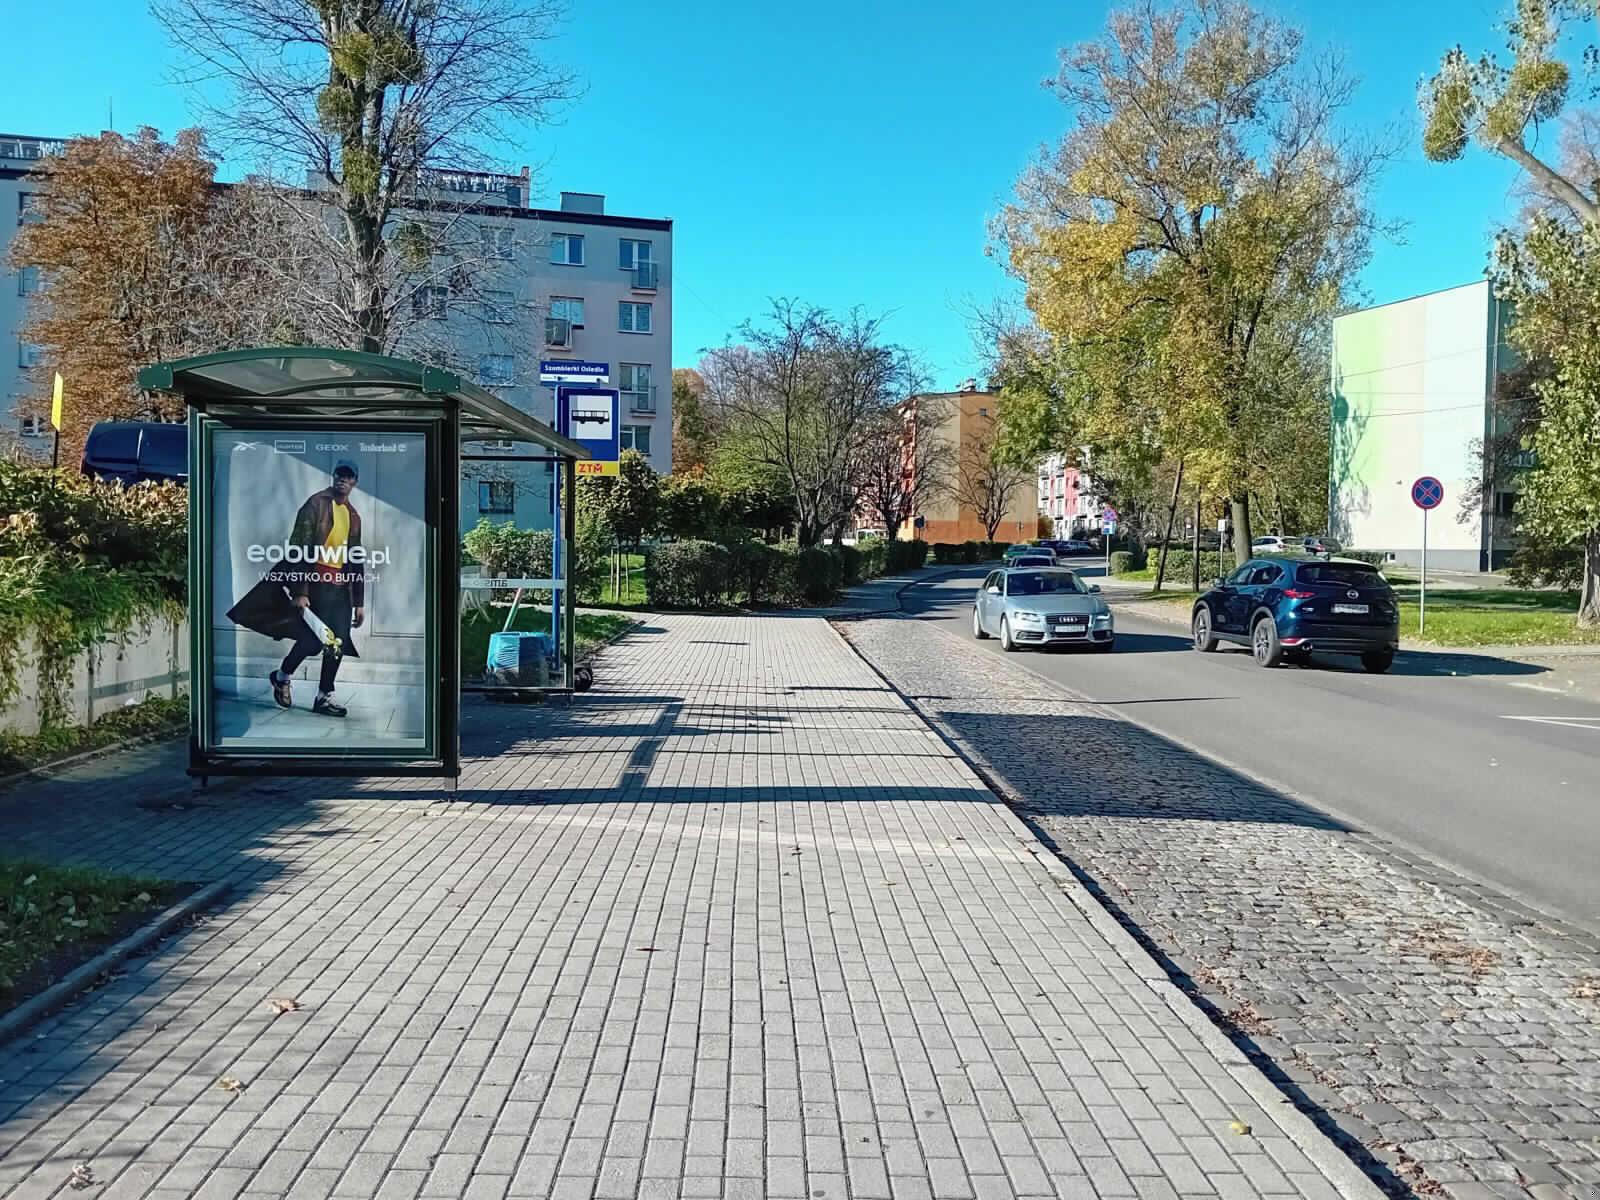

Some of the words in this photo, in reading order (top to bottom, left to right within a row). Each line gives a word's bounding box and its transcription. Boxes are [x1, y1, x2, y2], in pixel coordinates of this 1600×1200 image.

[315, 443, 349, 451] GEOX
[578, 463, 603, 473] ZTM
[246, 540, 391, 568] eobuwie.pl
[259, 572, 320, 583] WSZYSTKO
[322, 572, 333, 583] O
[335, 572, 380, 583] BUTACH
